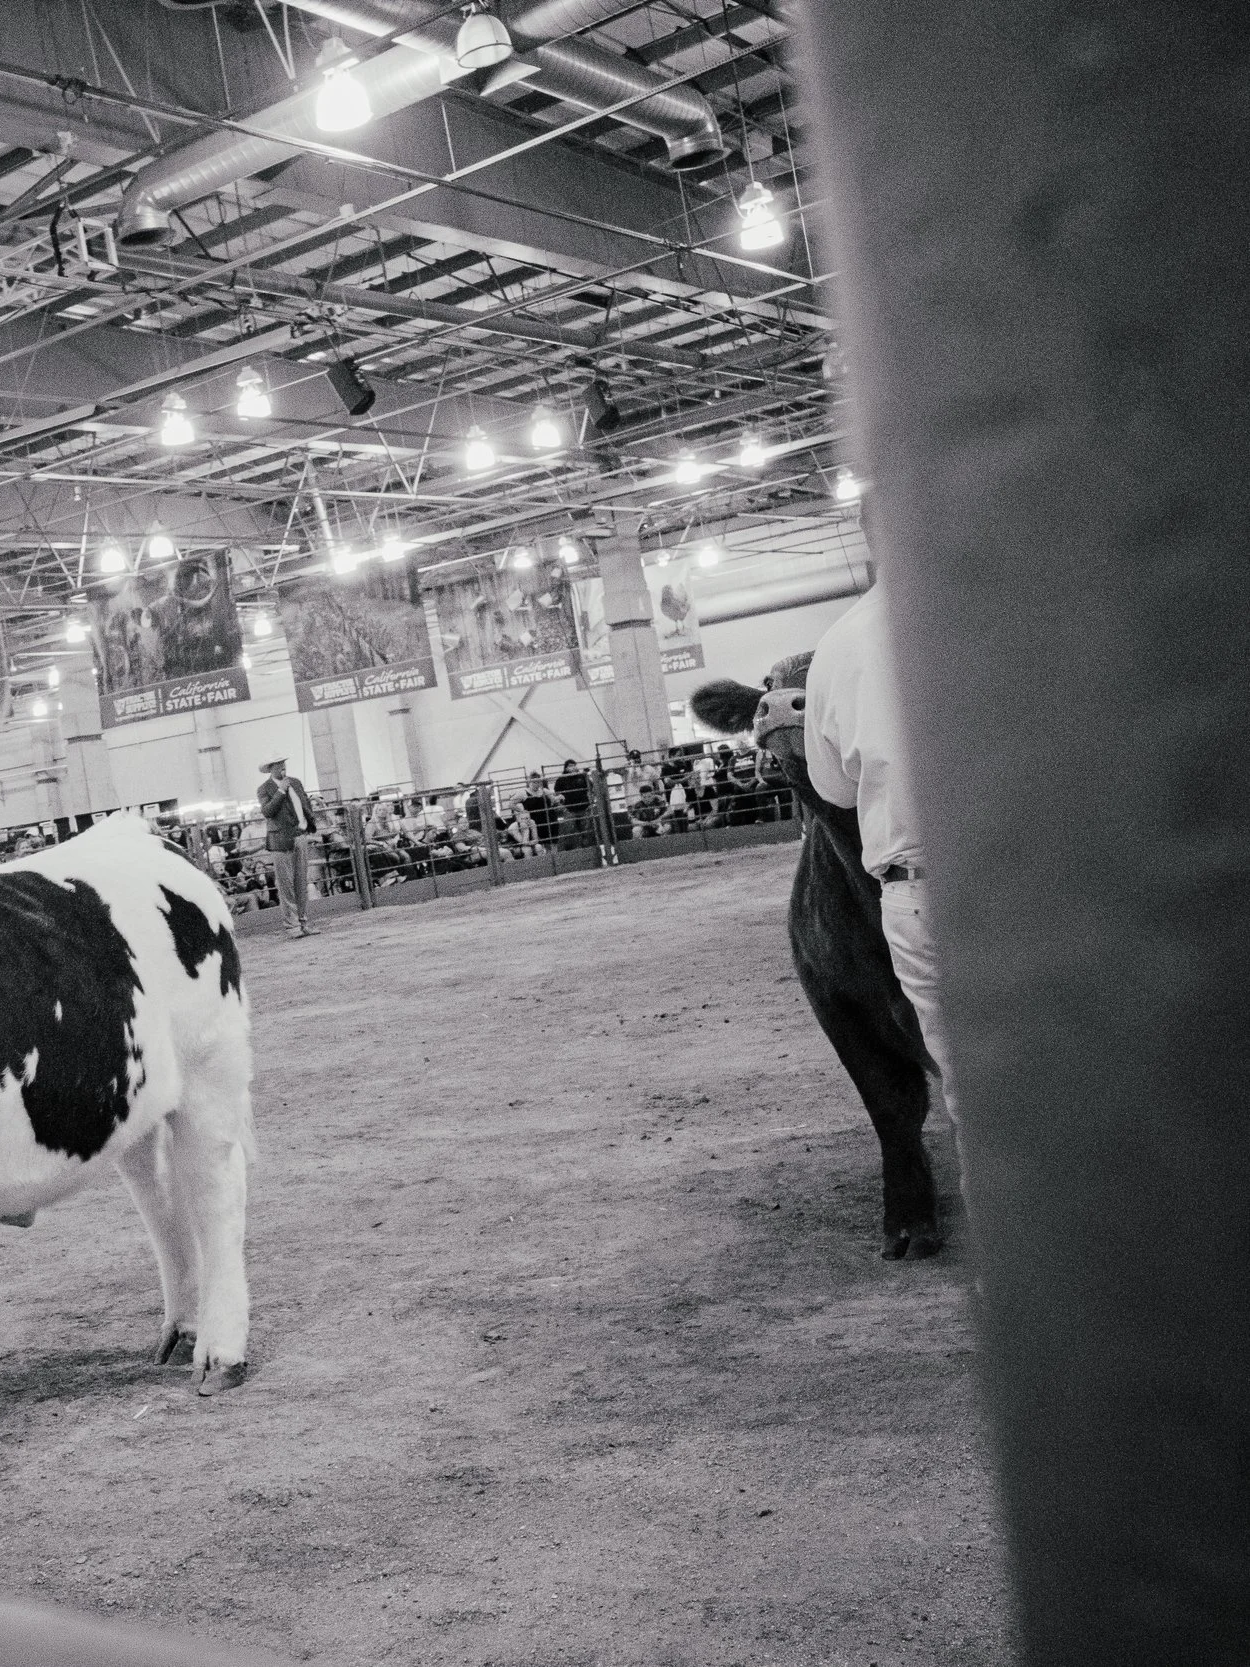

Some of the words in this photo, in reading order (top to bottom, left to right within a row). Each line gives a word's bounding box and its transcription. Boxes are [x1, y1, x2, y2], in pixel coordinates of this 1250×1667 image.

[362, 681, 395, 697] STATE
[399, 675, 426, 690] FAIR
[510, 671, 542, 686] STATE
[547, 665, 571, 679] FAIR
[169, 678, 230, 698] California
[165, 693, 202, 711] STATE
[207, 687, 237, 703] FAIR
